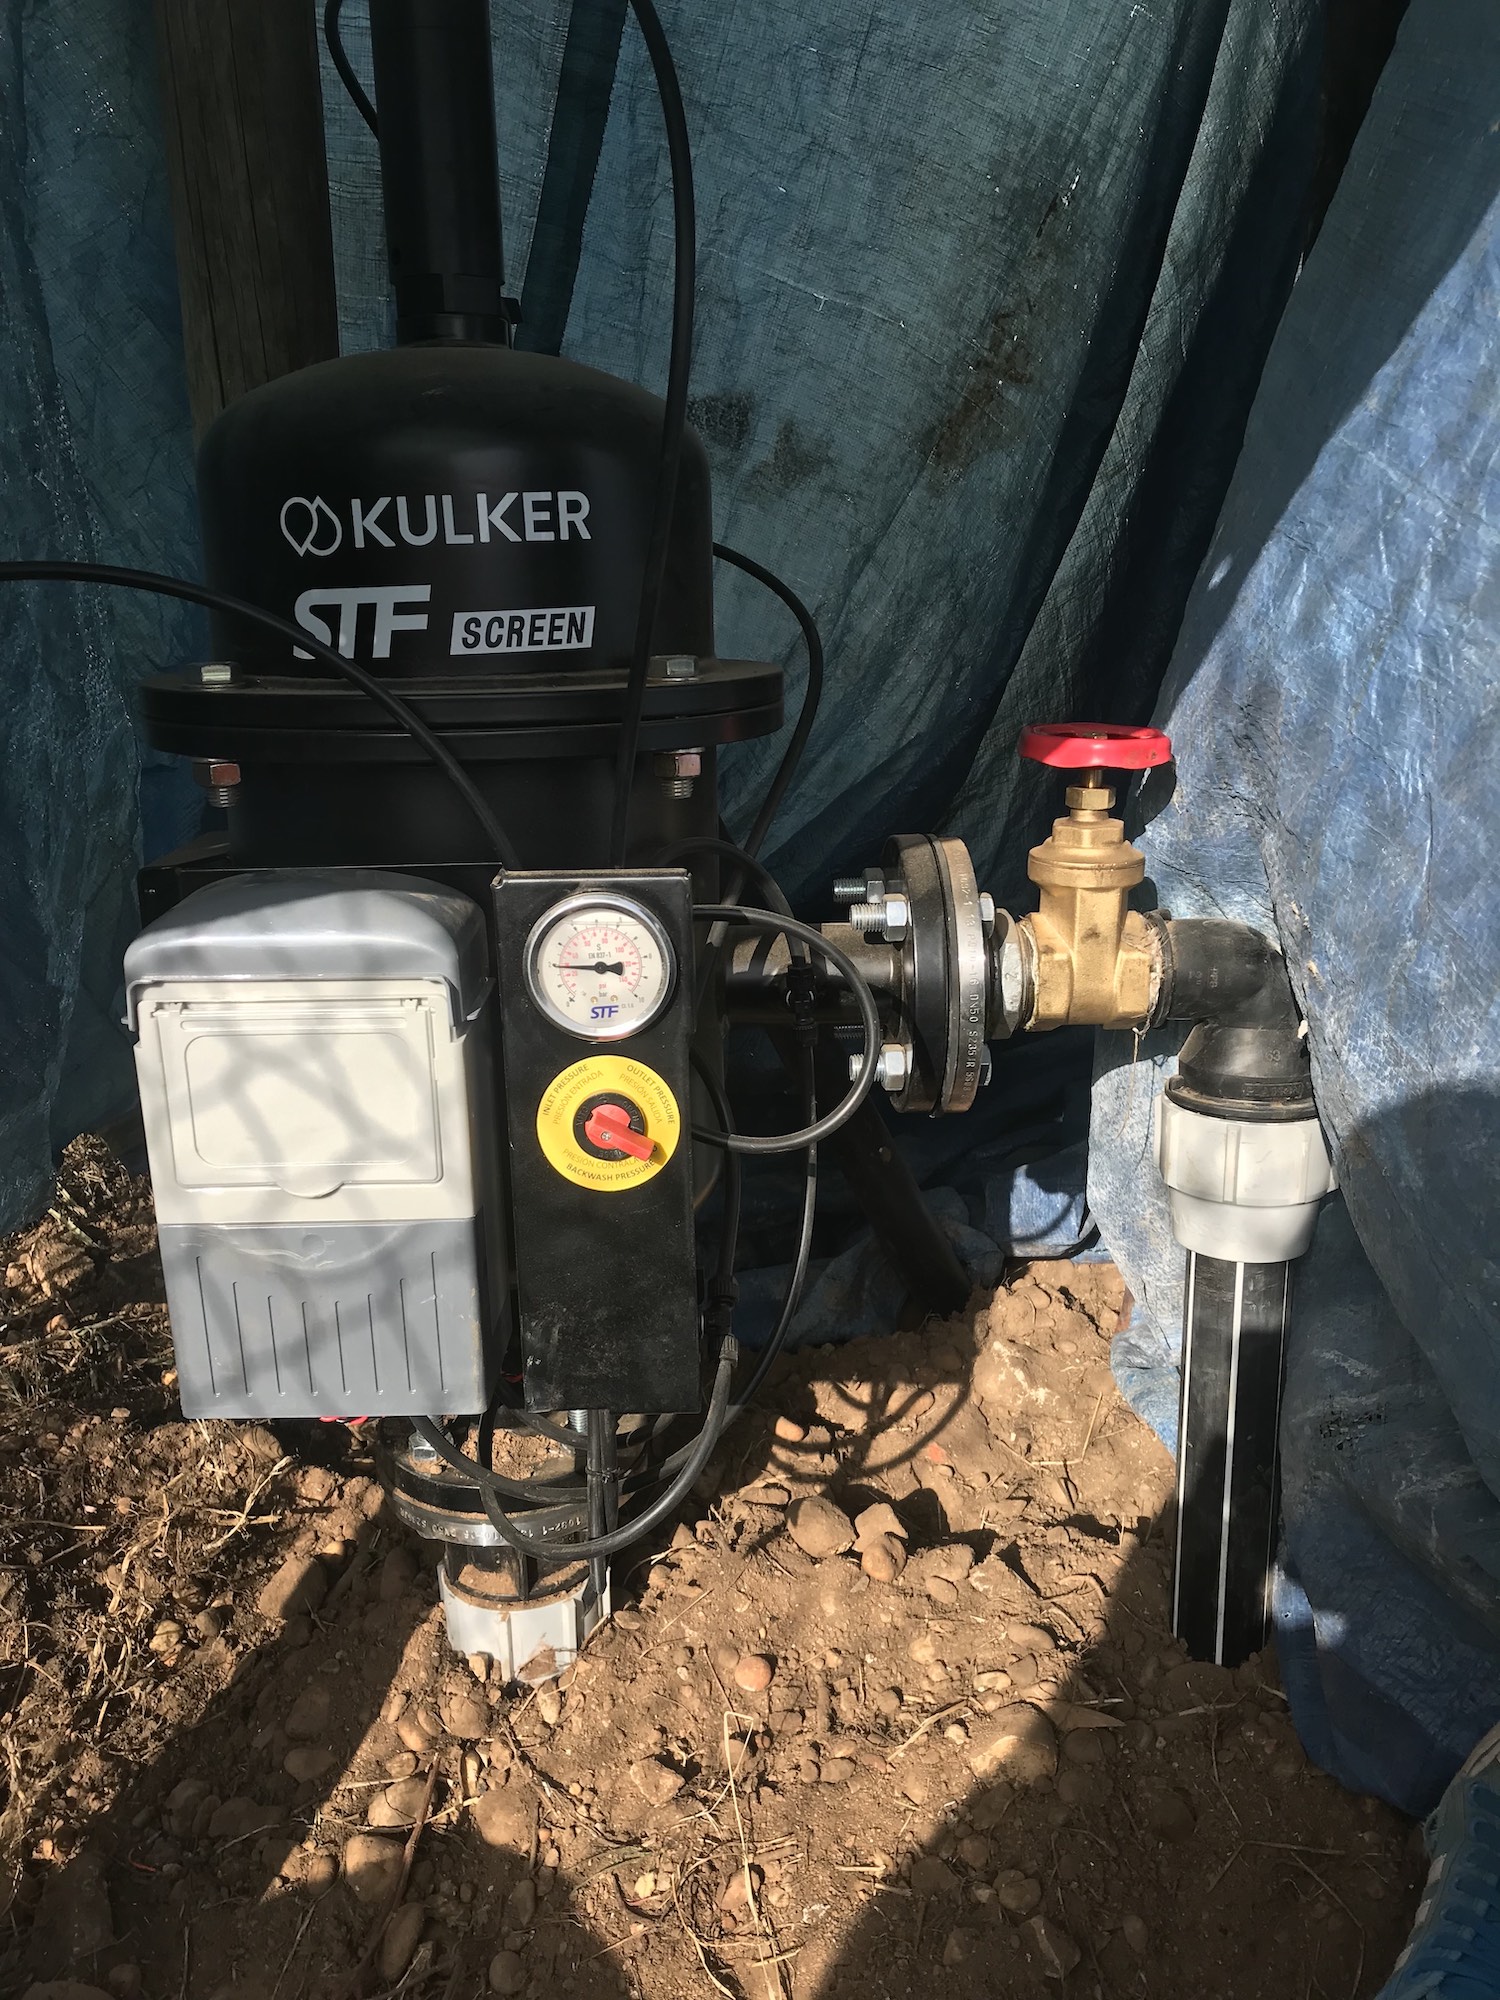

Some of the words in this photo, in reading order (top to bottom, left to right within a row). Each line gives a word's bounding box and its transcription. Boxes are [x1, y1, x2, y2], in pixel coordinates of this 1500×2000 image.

[351, 491, 592, 549] KULKER
[293, 584, 431, 660] STF
[461, 611, 587, 650] SCREEN
[590, 1005, 619, 1019] STF
[542, 1092, 557, 1116] INLET
[553, 1063, 589, 1094] PRESSURE
[569, 1070, 604, 1095] ENTRADA
[626, 1064, 657, 1087] OUTLET
[654, 1085, 676, 1125] PRESSURE
[646, 1096, 663, 1124] SALIDA
[566, 1163, 613, 1181] BACKWASH
[615, 1159, 655, 1181] PRESSURE
